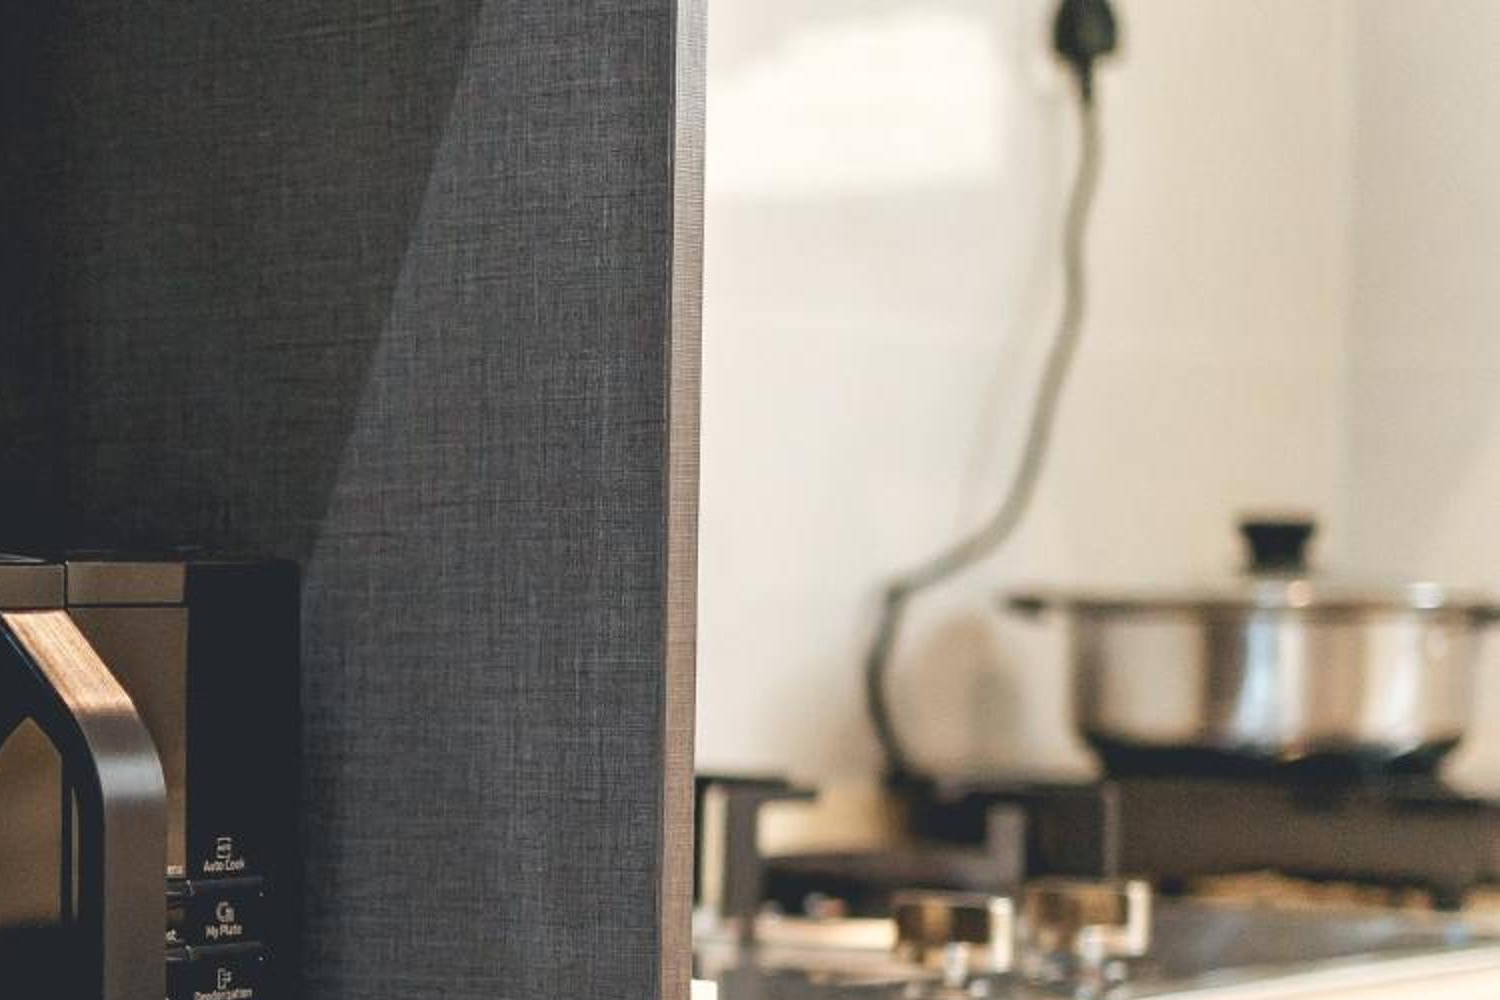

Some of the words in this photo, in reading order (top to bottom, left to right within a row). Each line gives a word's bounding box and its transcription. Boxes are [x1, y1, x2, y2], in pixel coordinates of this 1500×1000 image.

[203, 860, 224, 872] Auto
[225, 858, 245, 871] Cook
[205, 925, 219, 939] My
[220, 923, 242, 935] Plate
